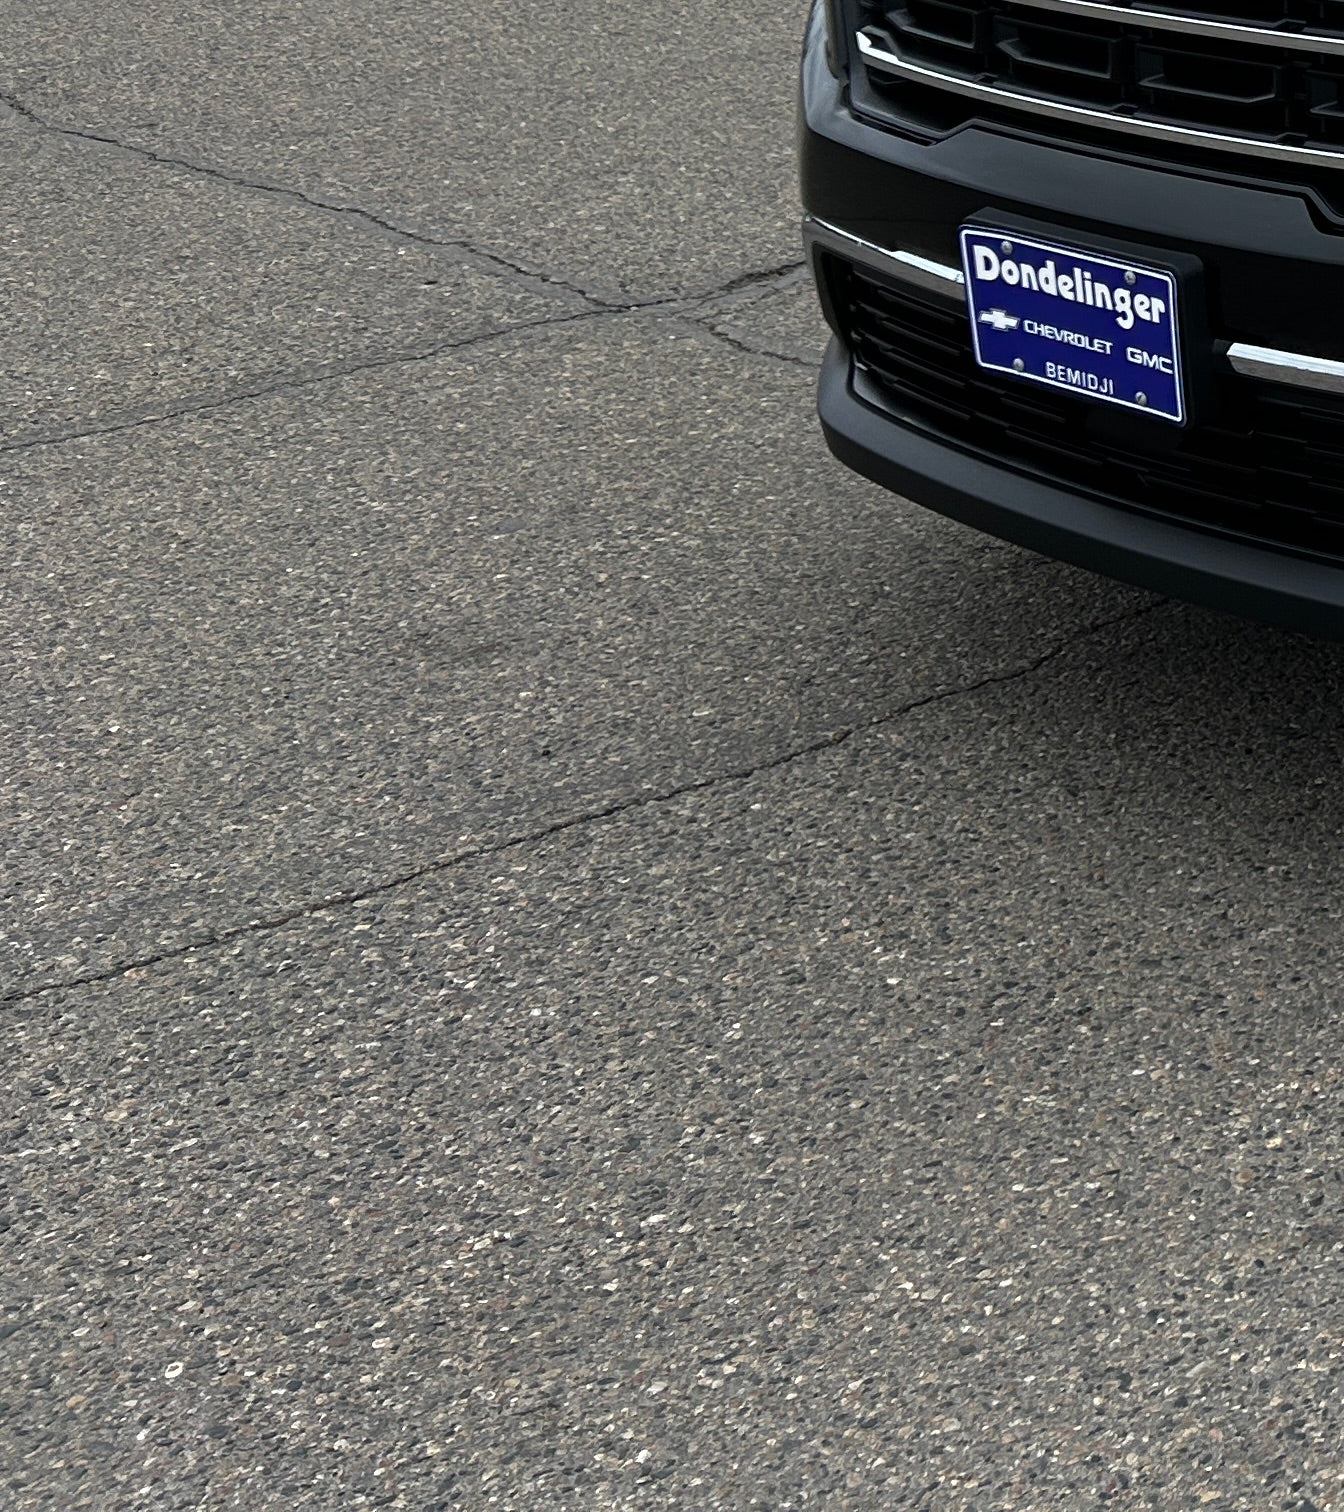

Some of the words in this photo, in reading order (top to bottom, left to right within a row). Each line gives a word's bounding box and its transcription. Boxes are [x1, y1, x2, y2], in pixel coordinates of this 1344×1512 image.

[972, 244, 1166, 329] Dondelinger
[1023, 319, 1113, 355] CHEVROLET
[1126, 346, 1174, 375] GMC
[1045, 361, 1114, 395] BEMIDJI
